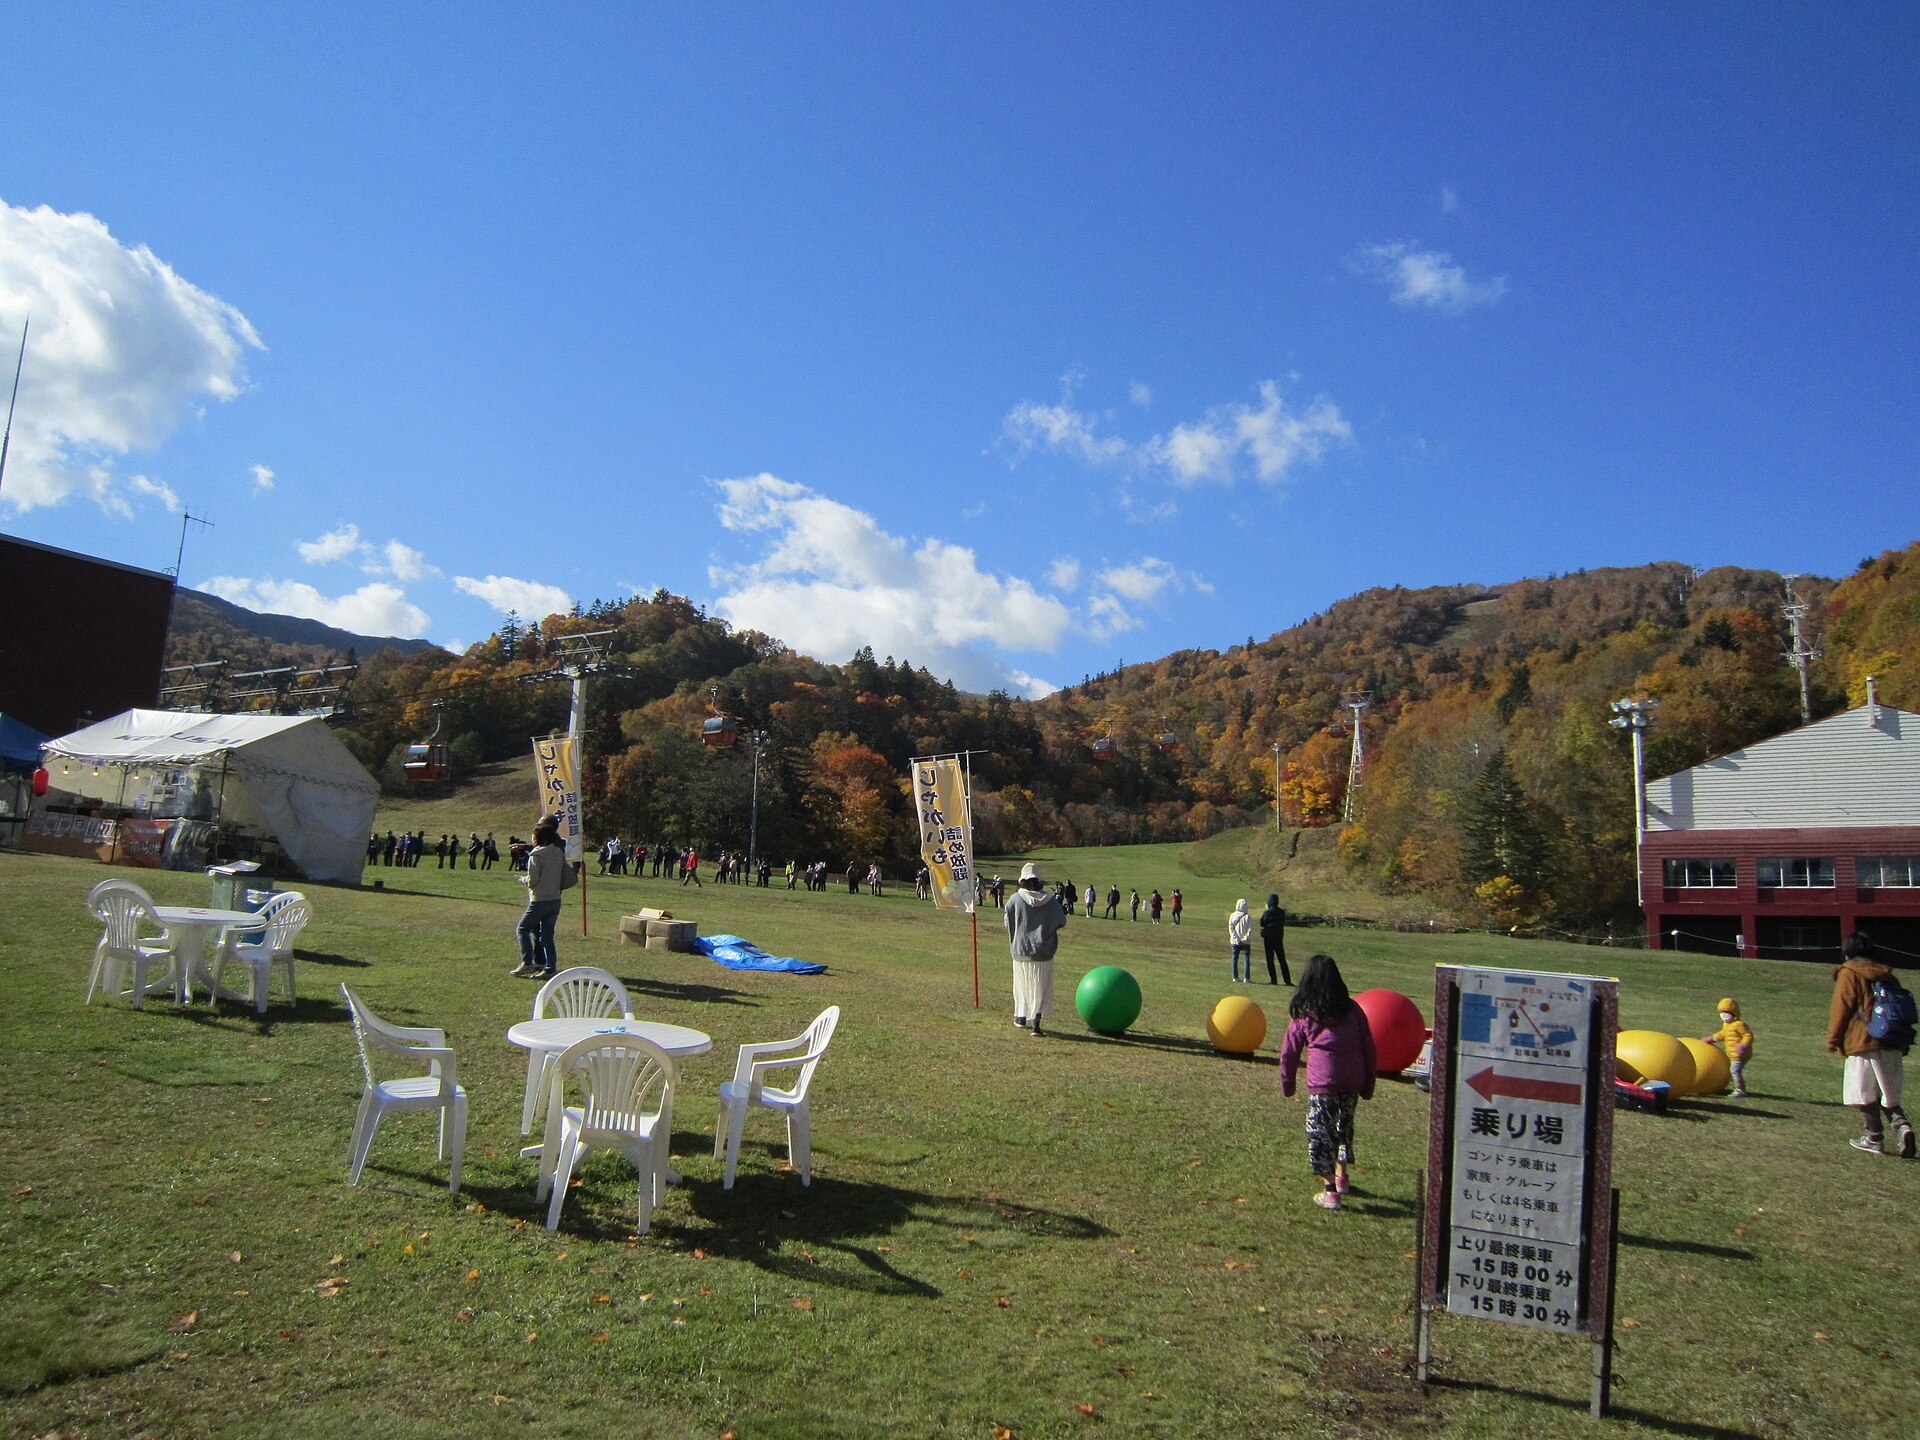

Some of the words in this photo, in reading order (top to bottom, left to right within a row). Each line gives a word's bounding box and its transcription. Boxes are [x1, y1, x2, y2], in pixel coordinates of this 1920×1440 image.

[1471, 1107, 1564, 1145] 乗り場
[1468, 1151, 1557, 1173] ゴンドラ乗車は
[1467, 1169, 1557, 1192] 家族・グループ
[1463, 1188, 1559, 1213] もしくは4名乗車
[1471, 1209, 1540, 1231] になります。
[1457, 1234, 1553, 1263] 上り最終乗車
[1455, 1272, 1552, 1302] 下り最終乗車
